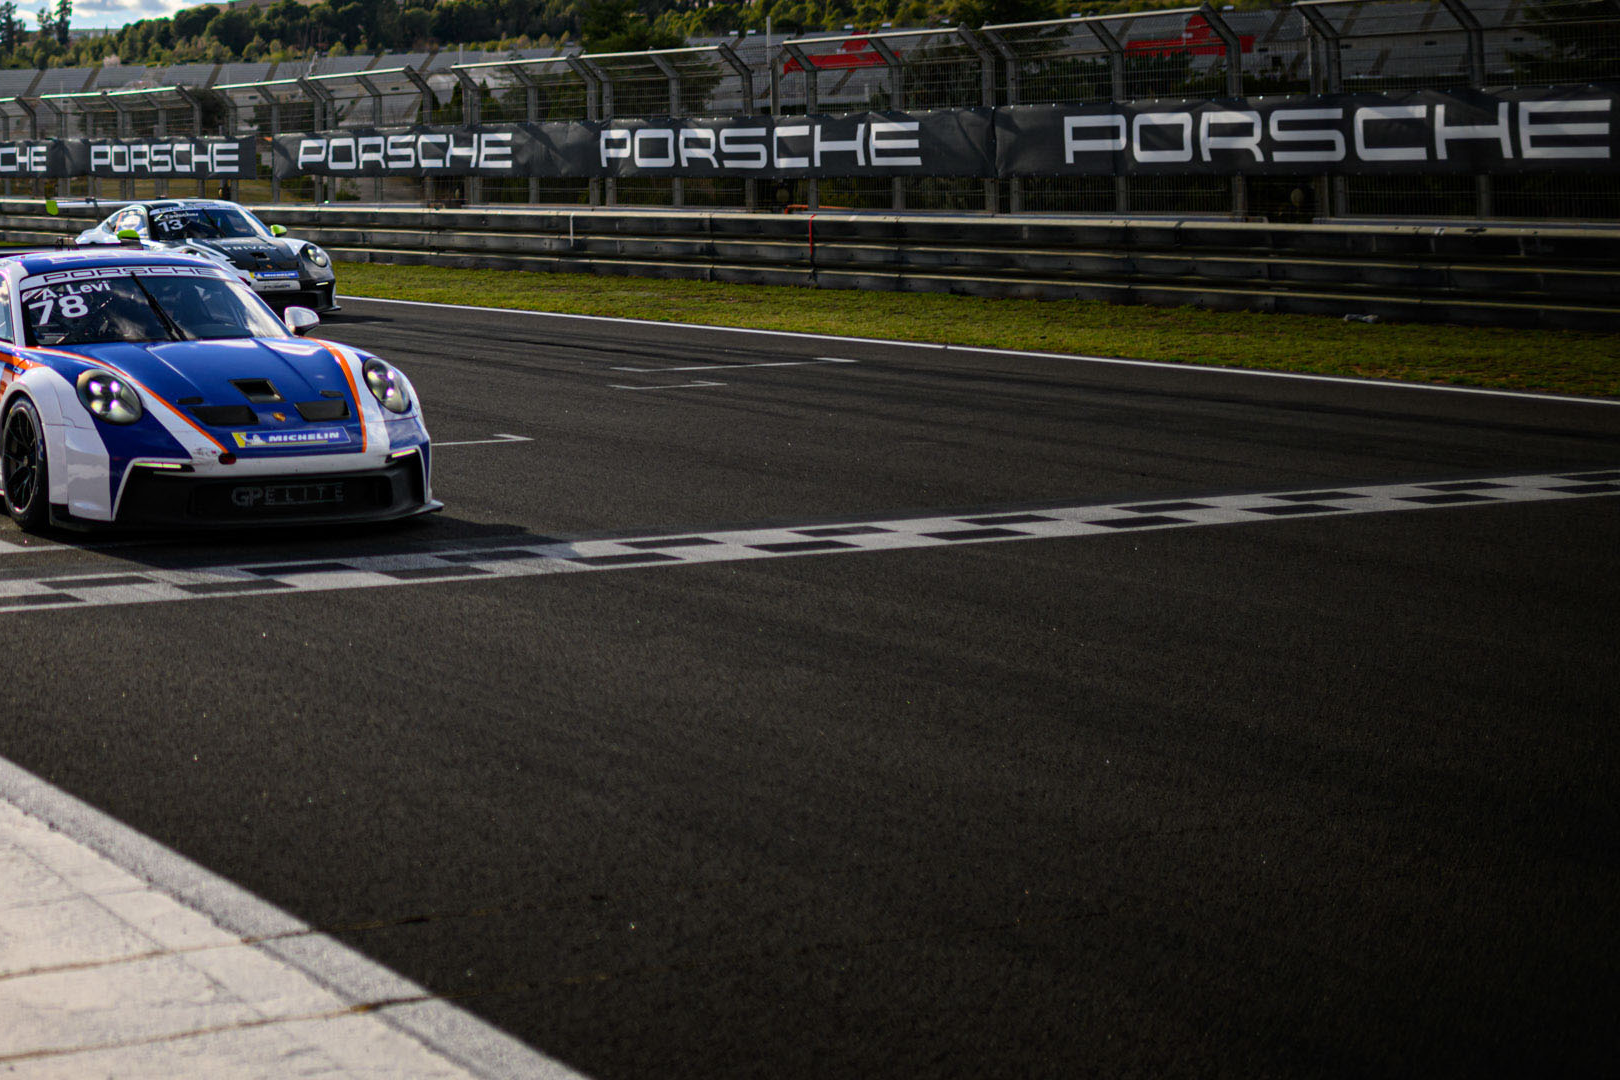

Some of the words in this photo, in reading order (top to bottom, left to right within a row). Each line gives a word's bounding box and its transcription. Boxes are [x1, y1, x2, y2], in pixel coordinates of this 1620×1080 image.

[600, 122, 922, 168] PORSCHE
[1064, 100, 1611, 163] PORSCHE
[91, 143, 239, 173] PORSCHE
[298, 133, 513, 170] PORSCHE
[157, 219, 184, 232] 13
[44, 267, 220, 283] PORSCHE
[42, 287, 64, 301] A.
[69, 280, 112, 295] Levi
[28, 295, 89, 326] 78
[268, 431, 340, 443] MICHELIN
